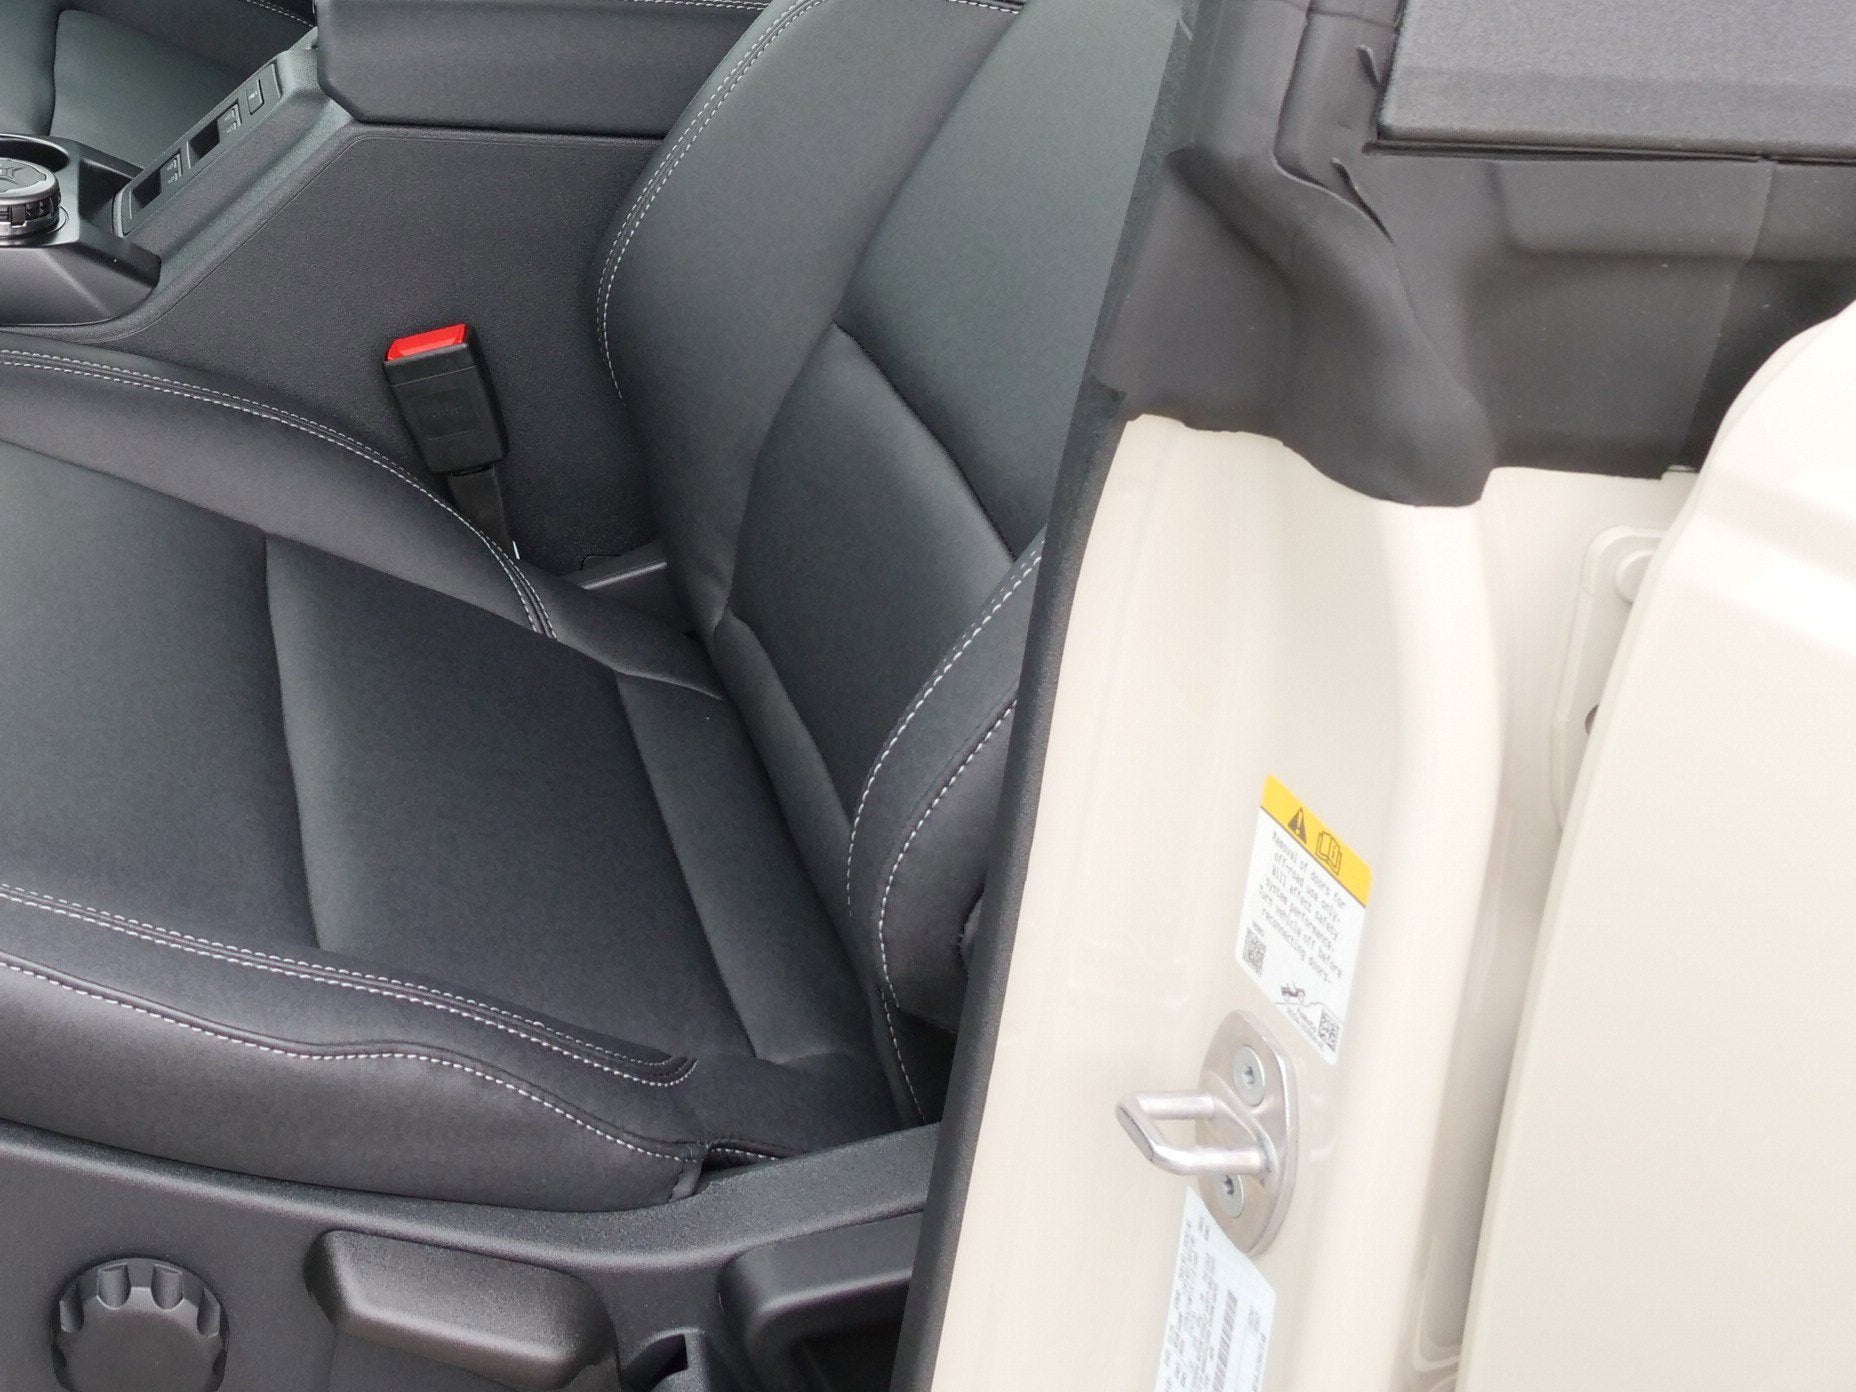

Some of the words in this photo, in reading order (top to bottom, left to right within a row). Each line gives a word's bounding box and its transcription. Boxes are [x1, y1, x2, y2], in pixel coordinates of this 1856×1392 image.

[1264, 874, 1288, 909] system
[1270, 828, 1299, 865] Removal
[1309, 867, 1331, 897] doors
[1332, 890, 1346, 912] for
[1270, 862, 1287, 888] Will
[1288, 880, 1313, 914] affect
[1313, 906, 1340, 944] safety
[1273, 848, 1304, 888] off-road
[1305, 882, 1319, 903] use
[1257, 882, 1274, 909] Turn
[1274, 900, 1302, 938] vehicle
[1302, 929, 1316, 952] off
[1317, 945, 1343, 981] before
[1260, 902, 1307, 963] reconnecting
